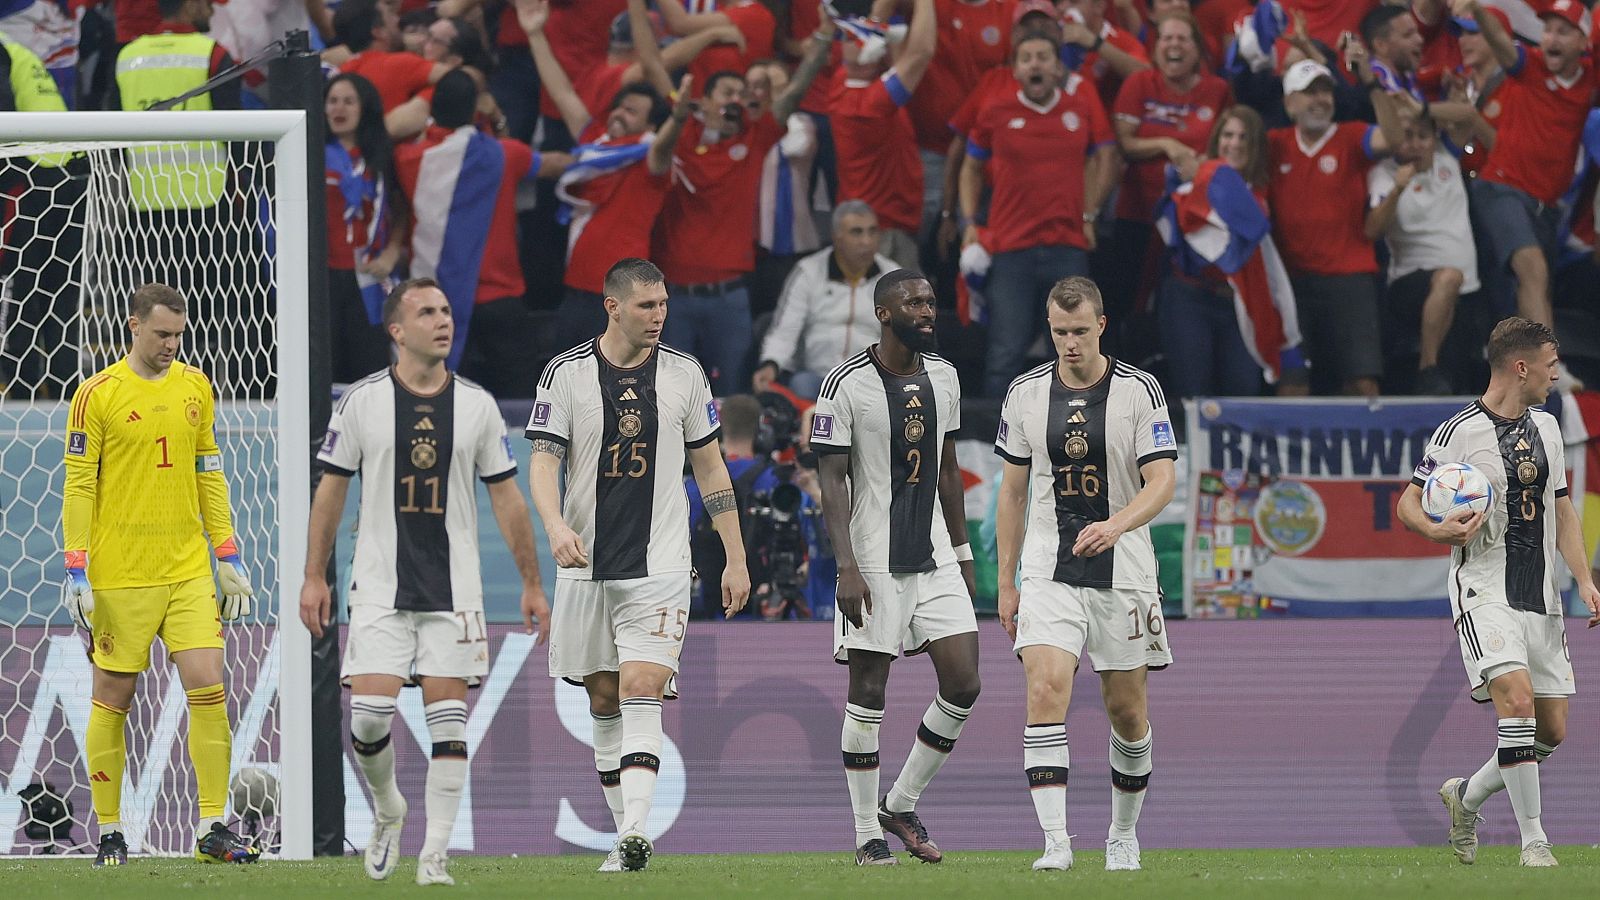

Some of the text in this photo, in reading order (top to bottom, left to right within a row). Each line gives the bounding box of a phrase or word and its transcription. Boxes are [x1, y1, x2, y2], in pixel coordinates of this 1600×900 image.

[156, 436, 173, 469] 1
[604, 442, 648, 478] 15
[906, 448, 921, 483] 2
[400, 475, 445, 514] 11
[1059, 464, 1100, 497] 16
[1363, 483, 1405, 531] T
[1521, 488, 1537, 521] 6
[455, 611, 487, 644] 11
[651, 606, 688, 642] 15
[1128, 602, 1163, 641] 16
[633, 756, 657, 766] DFB
[1515, 749, 1534, 758] DFB
[1031, 771, 1055, 781] DFB
